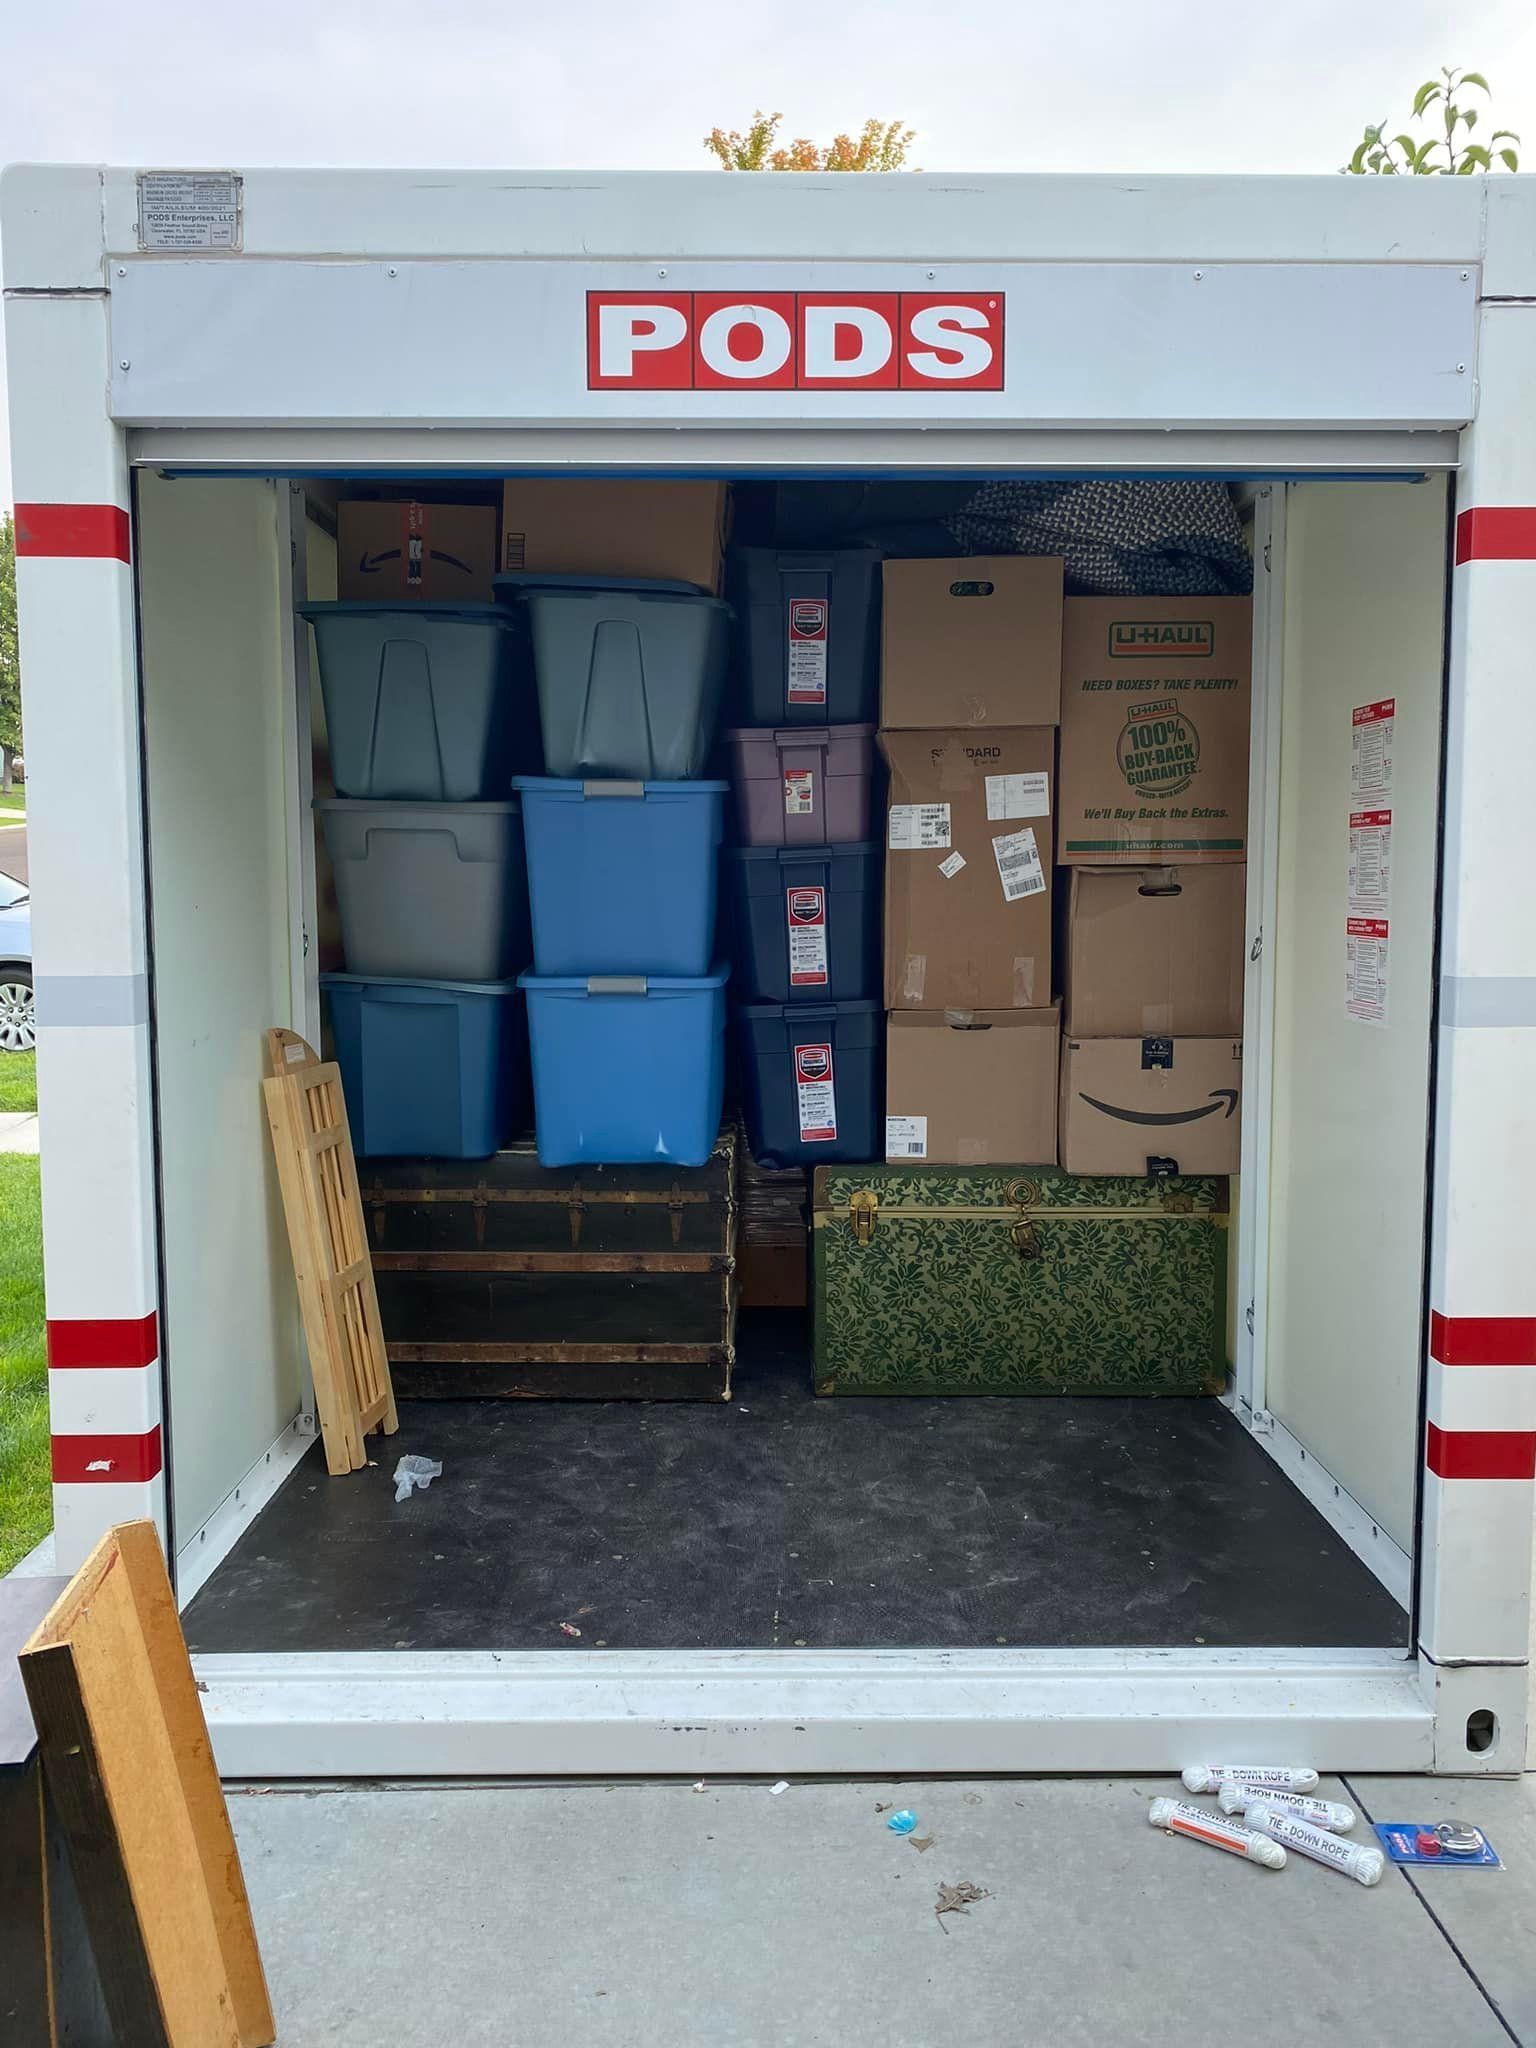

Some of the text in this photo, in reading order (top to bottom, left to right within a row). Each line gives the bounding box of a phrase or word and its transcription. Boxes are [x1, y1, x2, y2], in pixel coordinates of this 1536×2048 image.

[219, 214, 234, 222] LLC
[599, 304, 993, 379] PODS
[1115, 626, 1208, 643] U-HAUL
[1082, 678, 1238, 691] NEED BOXES? TAKE PLENTY!
[1131, 701, 1176, 716] U-HAUL
[1127, 718, 1186, 750] 100%
[1124, 743, 1196, 771] BUY-BACK
[1084, 807, 1228, 821] We'll Buy Back the Extras.
[1126, 841, 1184, 850] uhaul.com
[1210, 1769, 1225, 1779] TIE
[1232, 1769, 1262, 1780] DOWN
[1264, 1771, 1291, 1782] ROPE
[1244, 1786, 1272, 1799] ROPE
[1273, 1792, 1305, 1806] DOWN
[1312, 1800, 1329, 1813] TIE
[1268, 1815, 1283, 1831] TIE
[1289, 1825, 1321, 1848] DOWN
[1321, 1838, 1350, 1861] ROPE
